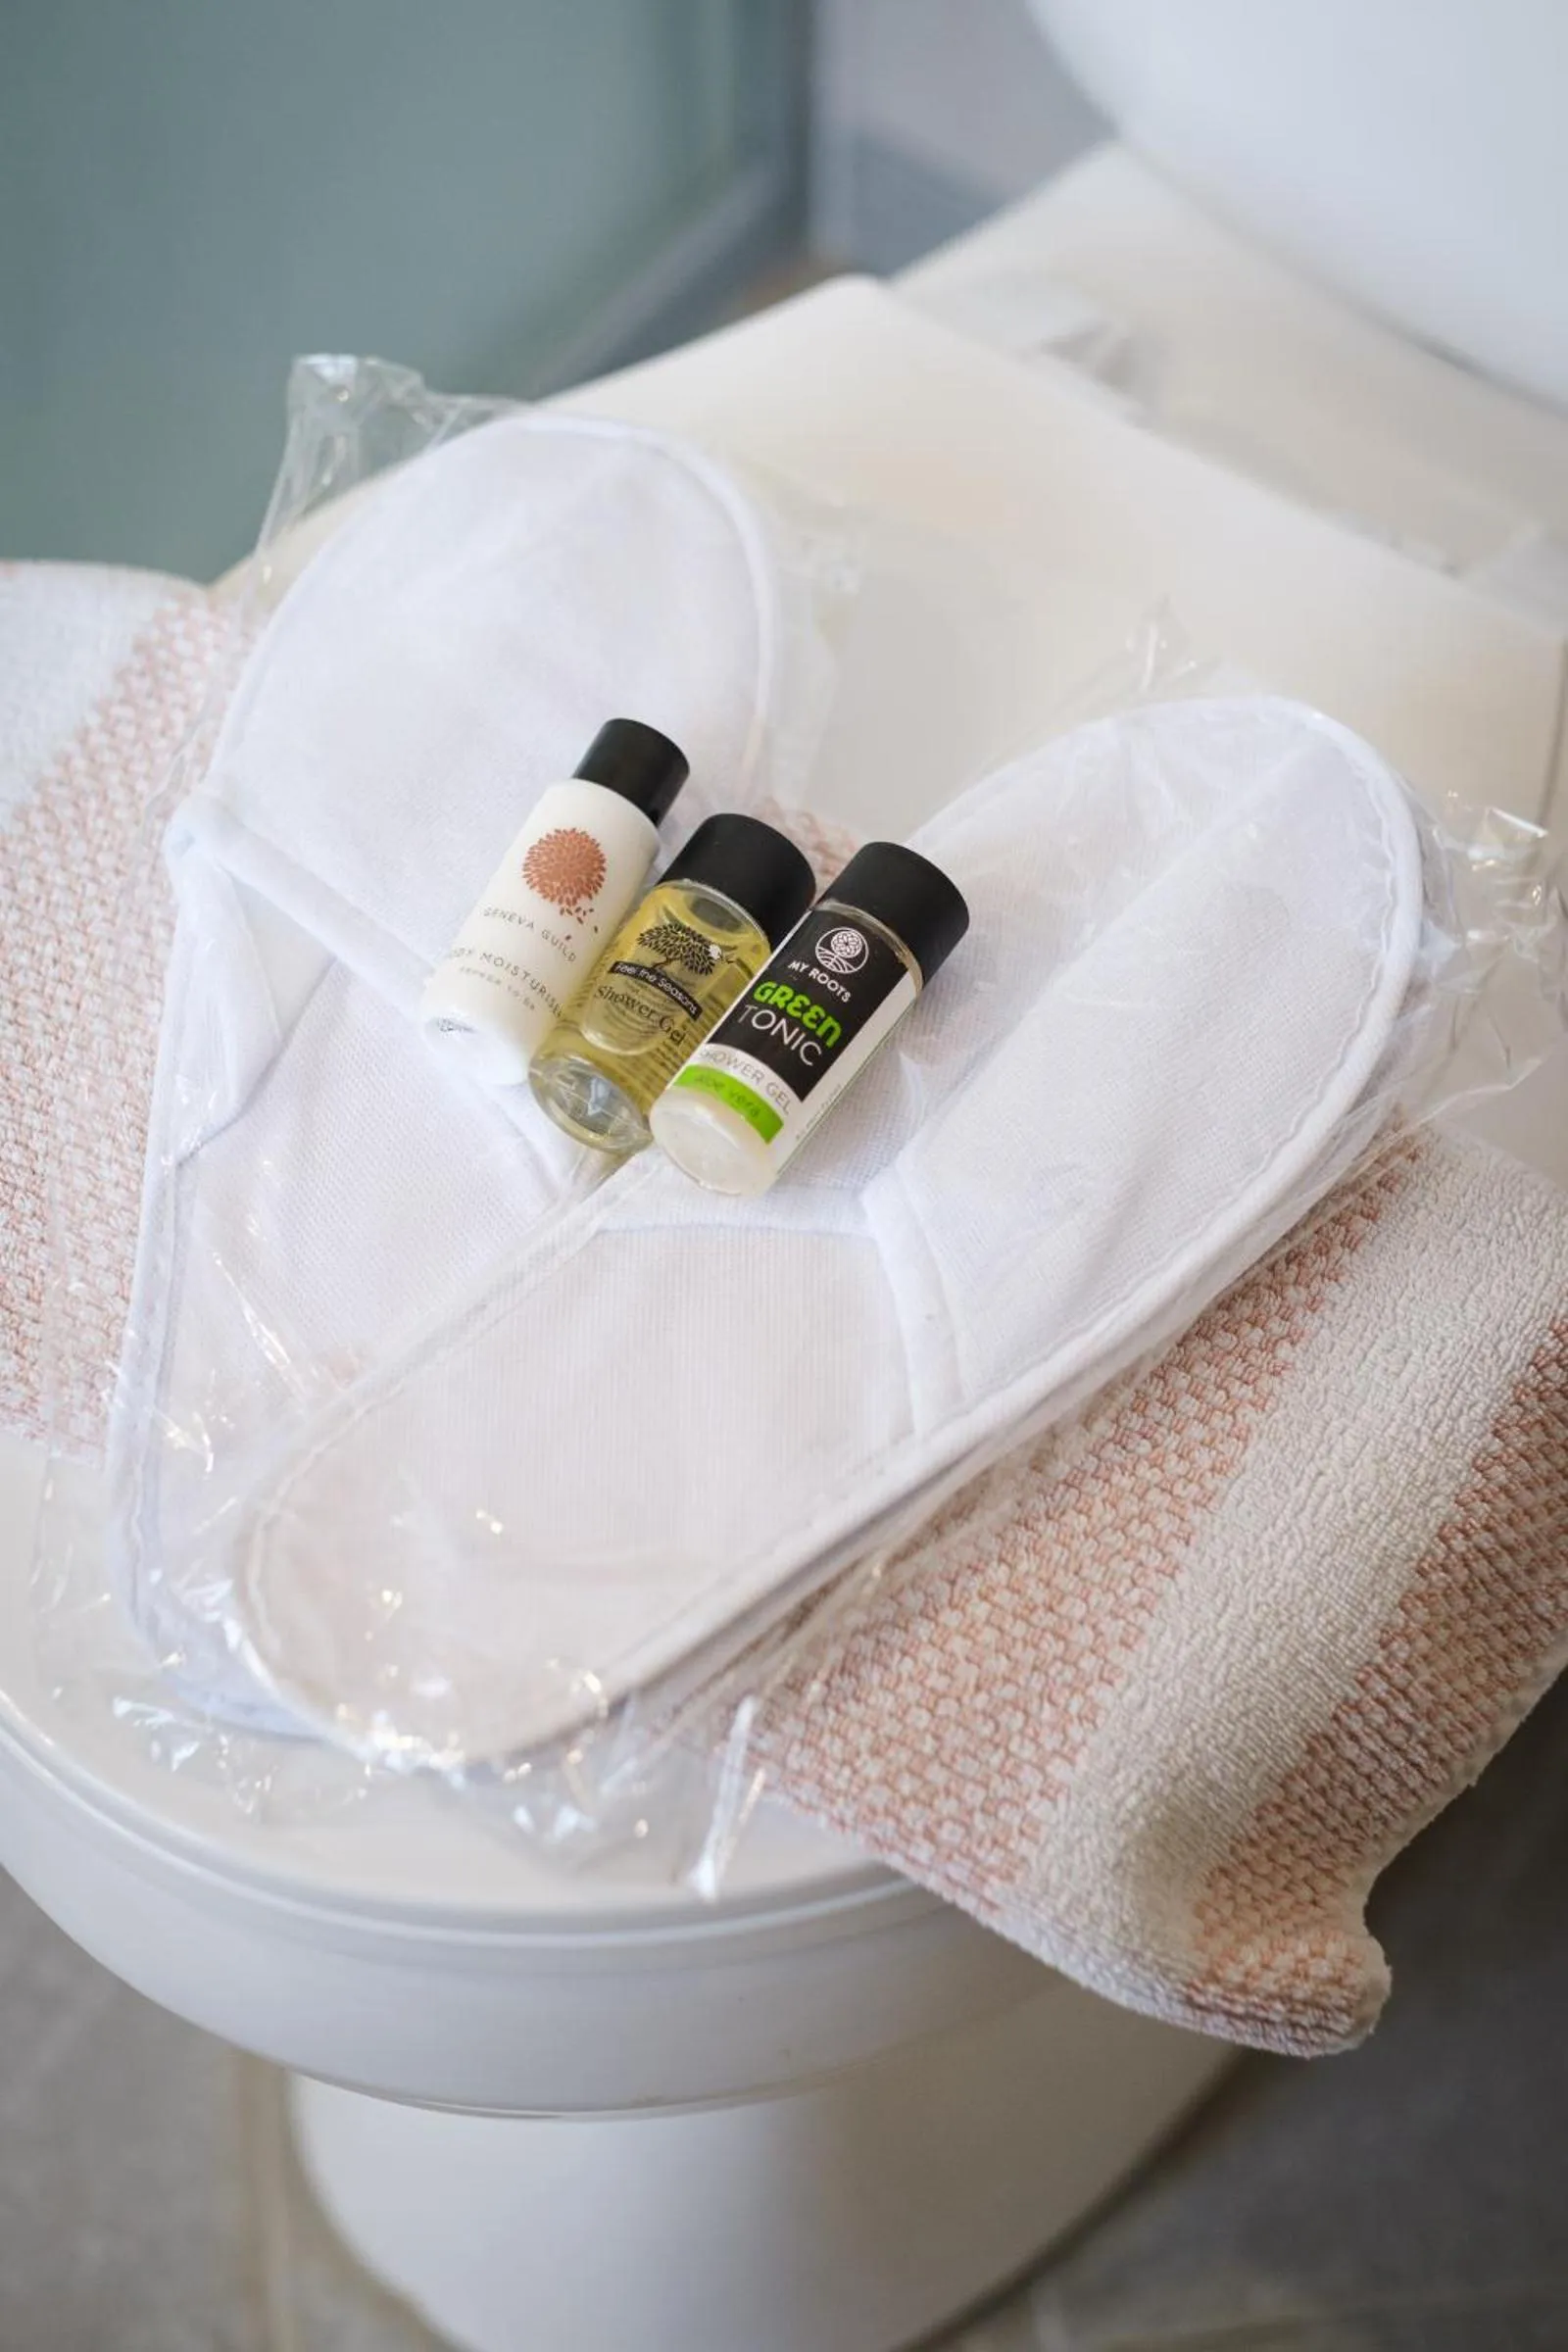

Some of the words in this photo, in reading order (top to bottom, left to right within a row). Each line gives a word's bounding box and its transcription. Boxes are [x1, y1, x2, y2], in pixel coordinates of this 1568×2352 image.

[541, 928, 577, 962] GUILD
[639, 968, 657, 982] the
[658, 978, 697, 1014] Seasons
[787, 960, 807, 972] MY
[808, 967, 852, 1003] ROOTS
[595, 984, 659, 1019] Shower
[660, 1015, 687, 1046] Gel
[738, 1004, 822, 1066] TONIC
[753, 982, 841, 1048] GREEN
[766, 1081, 790, 1115] GEL
